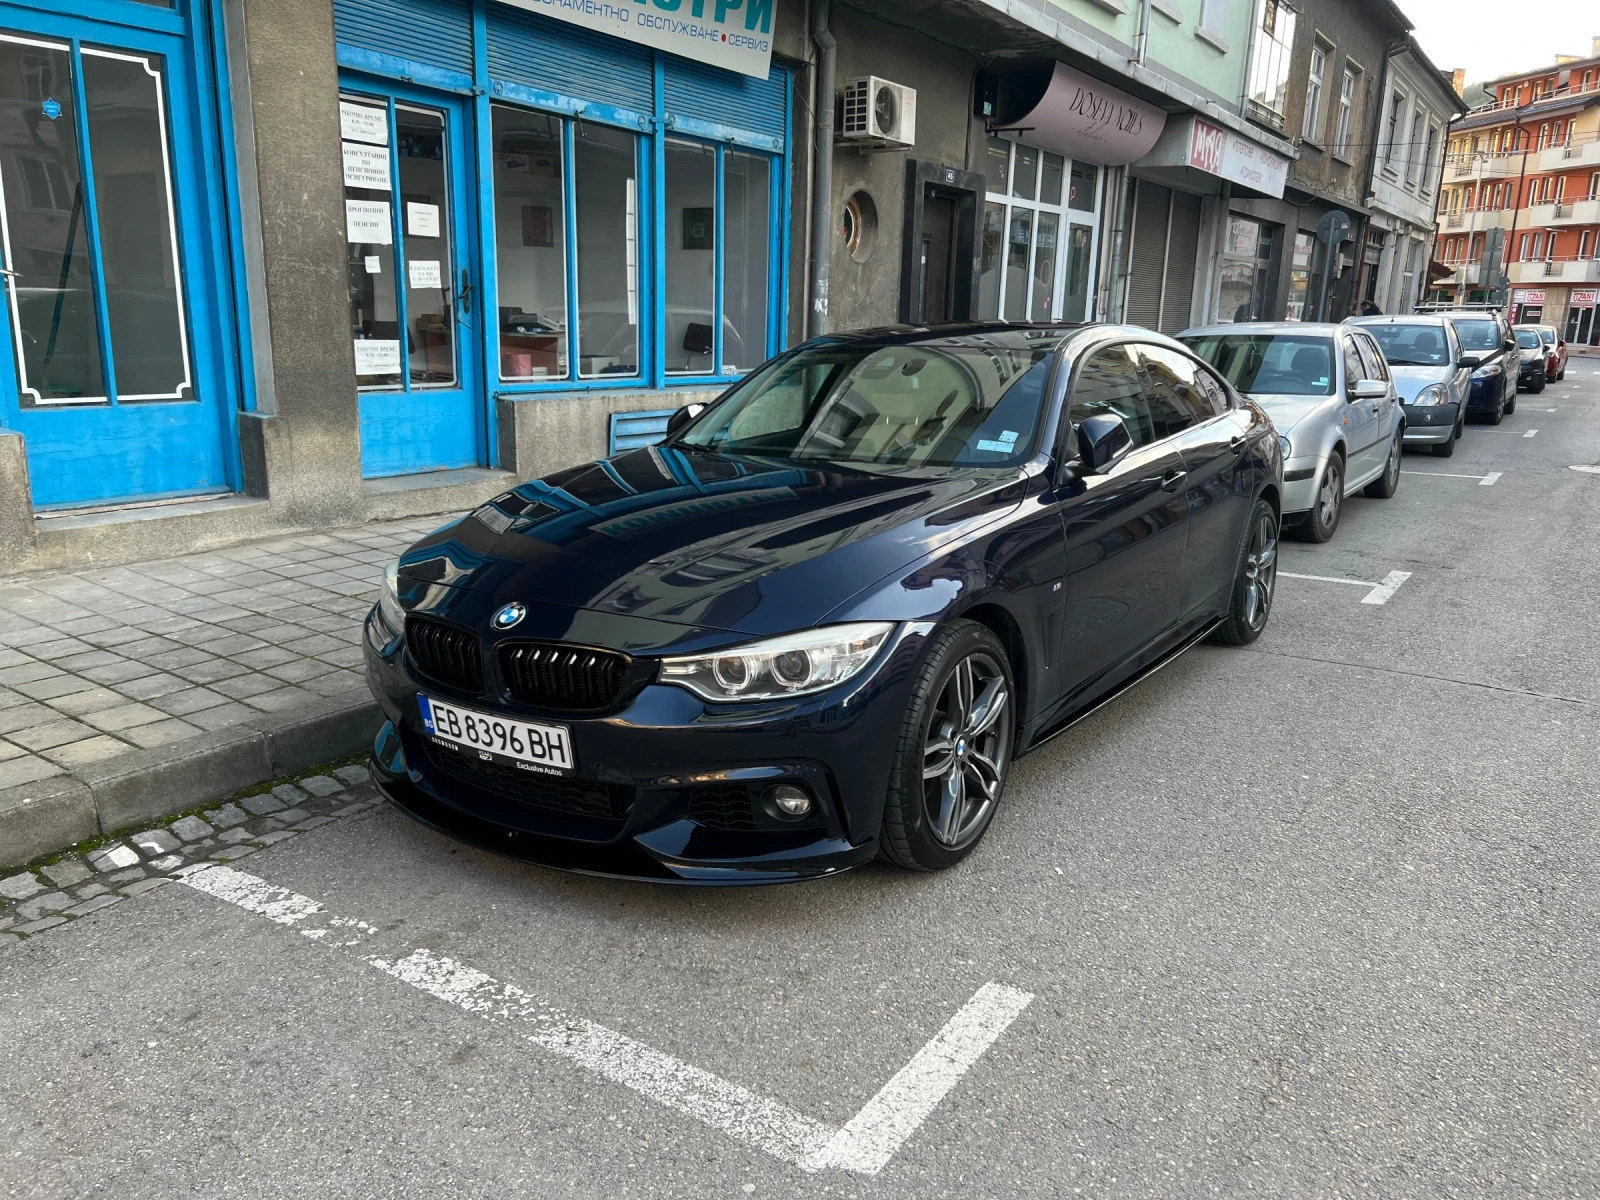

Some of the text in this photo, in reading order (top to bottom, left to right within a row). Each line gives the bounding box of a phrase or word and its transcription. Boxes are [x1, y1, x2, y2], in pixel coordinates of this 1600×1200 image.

[533, 0, 769, 52] НАМЕНТНО ОБСЛУЖВАНЕ СЕРВИЗ
[433, 704, 462, 739] EB
[465, 715, 525, 754] 8396
[527, 728, 566, 764] BH
